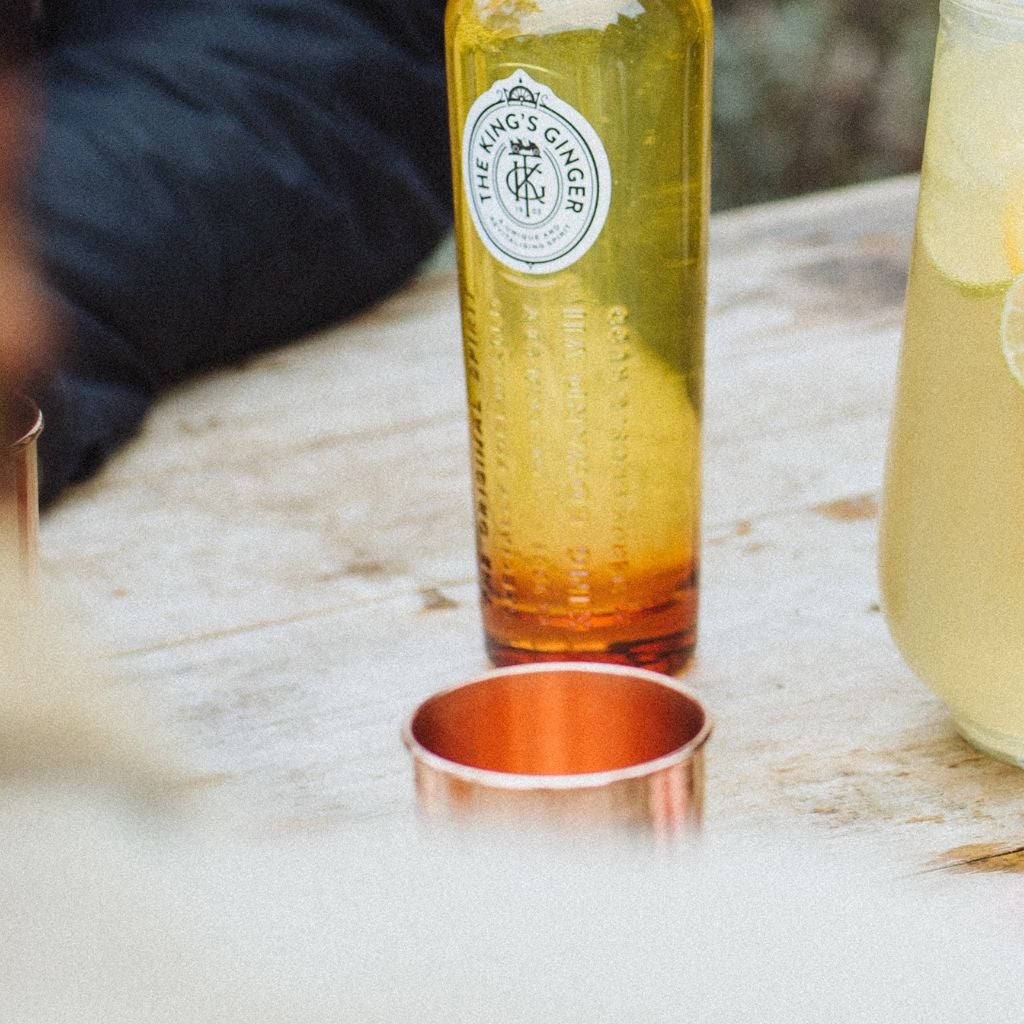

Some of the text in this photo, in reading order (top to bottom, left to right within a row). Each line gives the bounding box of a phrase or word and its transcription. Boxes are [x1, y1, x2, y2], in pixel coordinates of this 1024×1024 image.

[476, 112, 586, 215] THE KING'S GINGER
